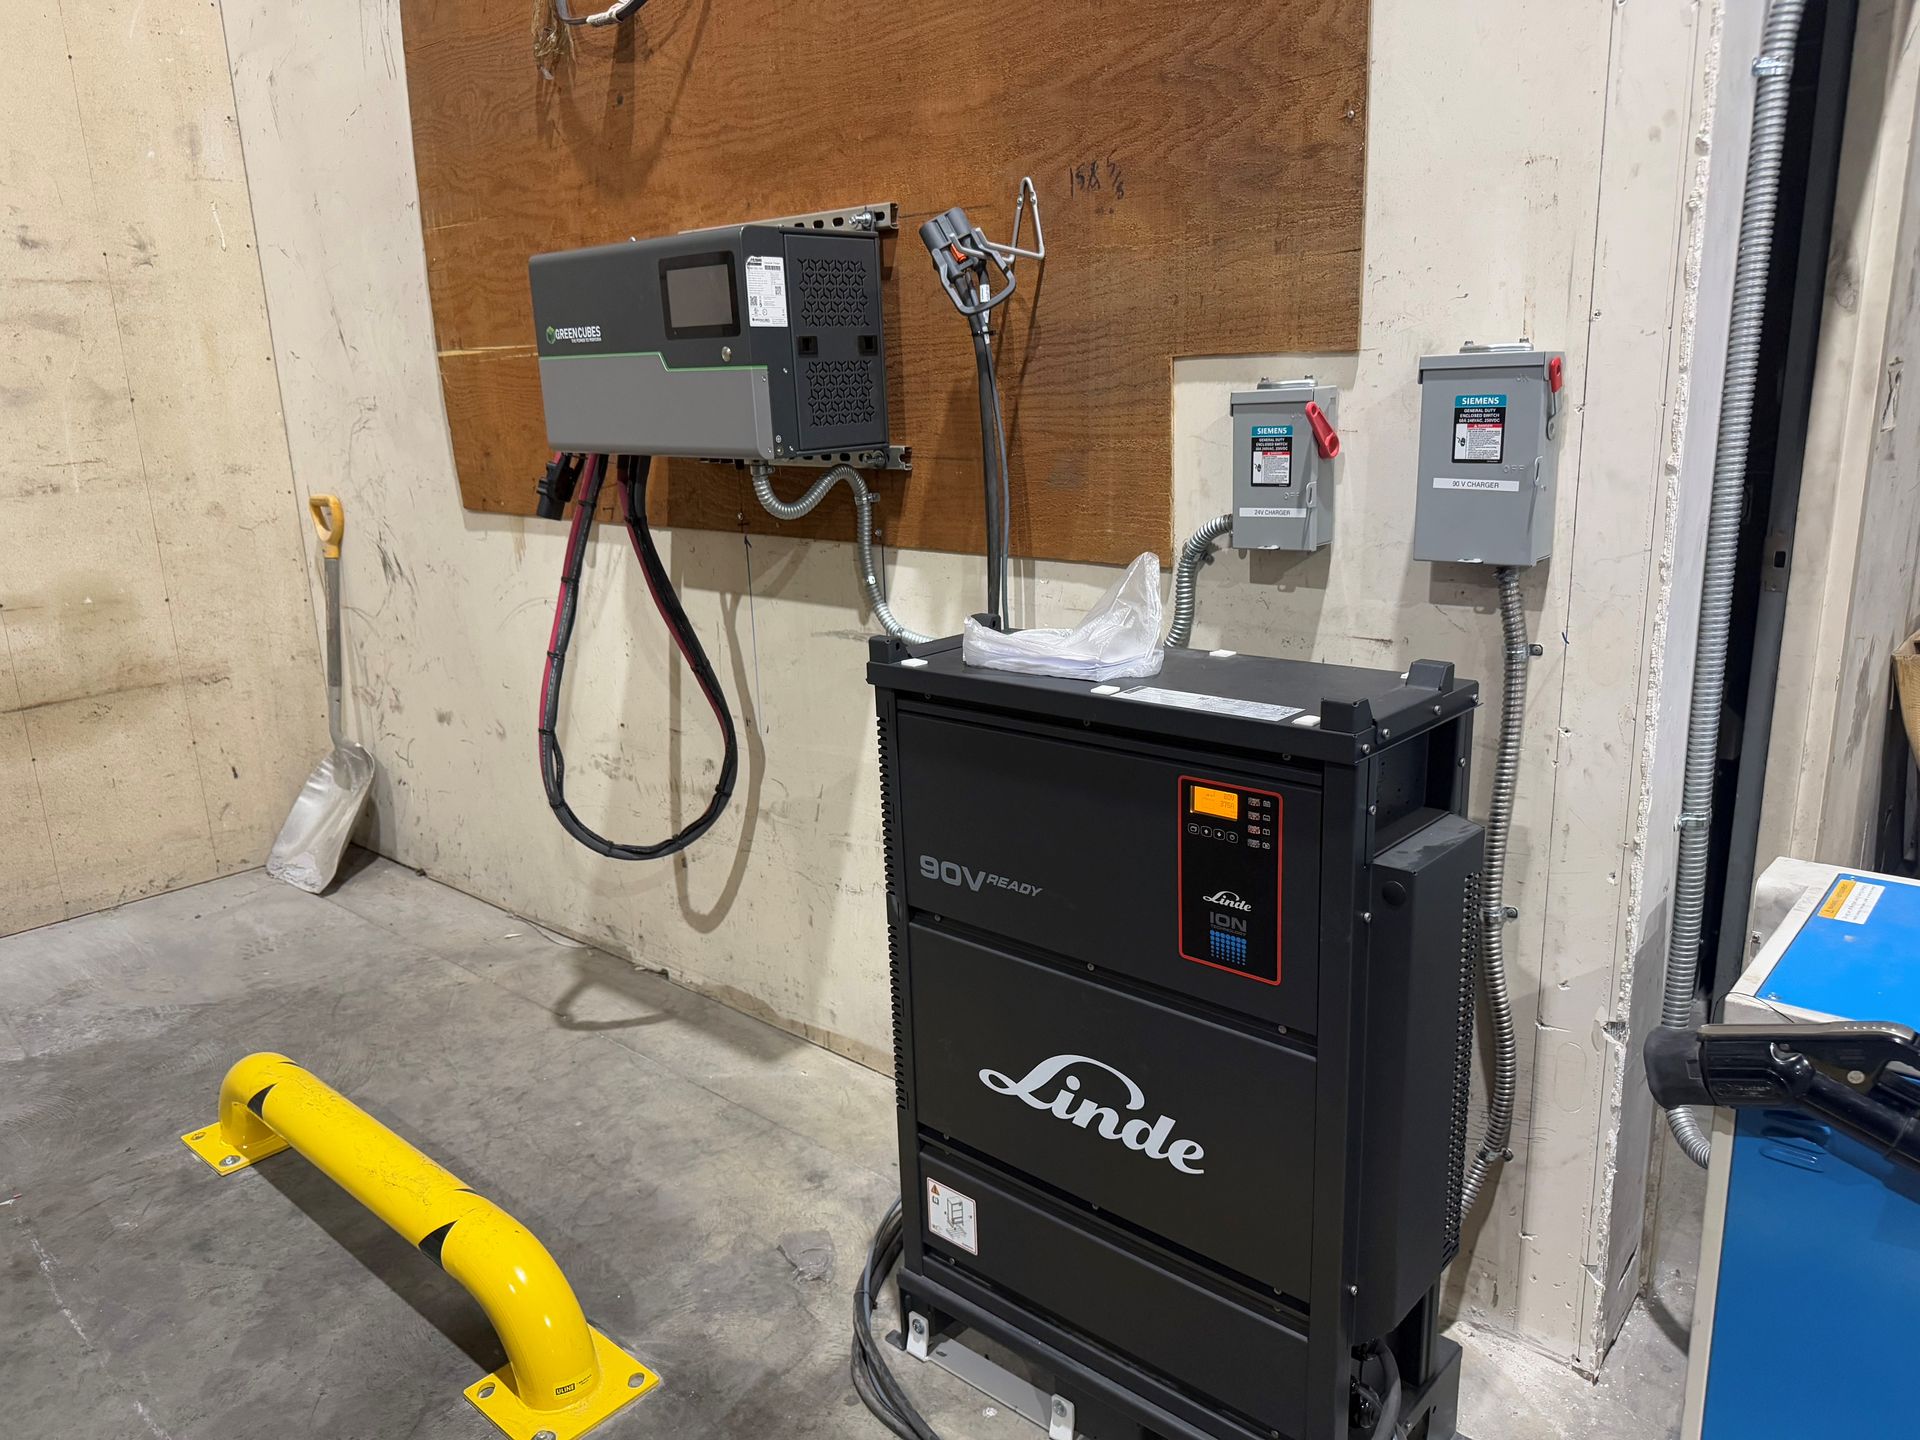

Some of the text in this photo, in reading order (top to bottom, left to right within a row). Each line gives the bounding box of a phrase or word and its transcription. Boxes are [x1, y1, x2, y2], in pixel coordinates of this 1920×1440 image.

[1461, 397, 1500, 405] SIEMENS
[1257, 427, 1287, 435] SIEMENS
[1466, 481, 1499, 489] CHARGER
[920, 854, 1043, 897] 90V READY
[1202, 890, 1252, 912] Linde
[1209, 911, 1247, 933] ION
[978, 1054, 1205, 1175] Linde
